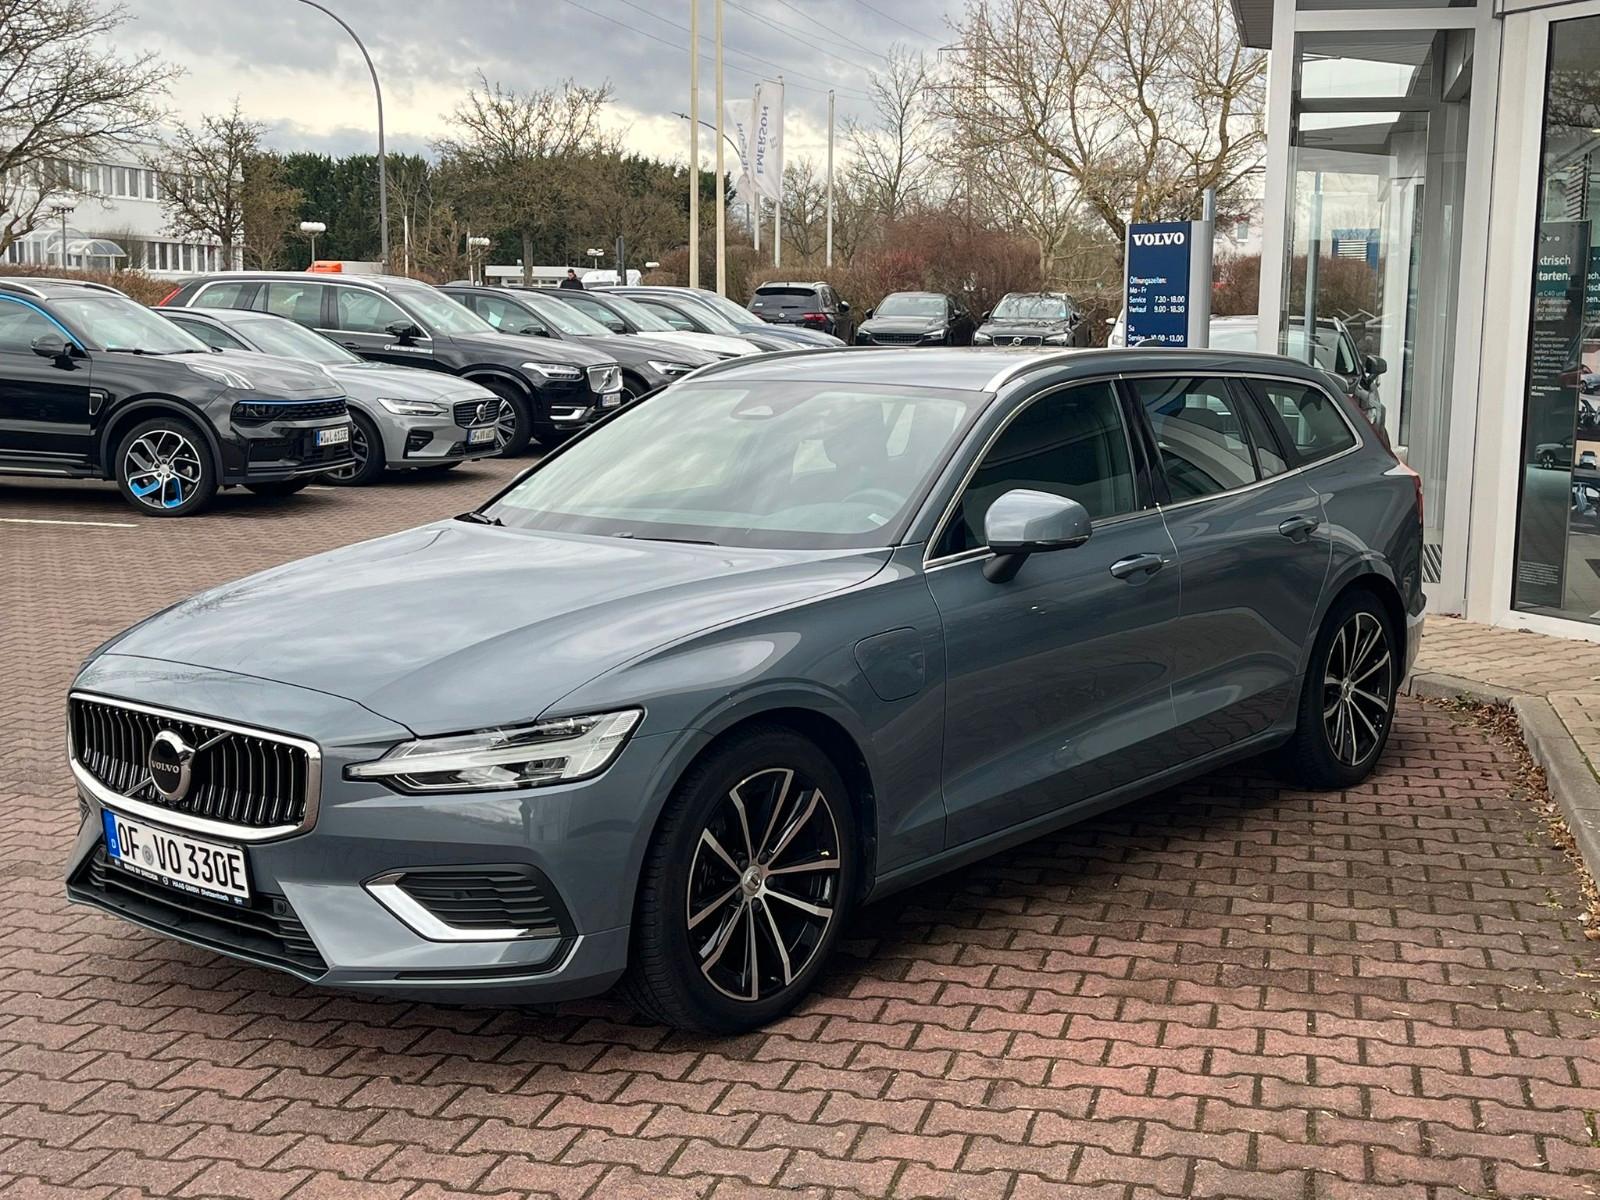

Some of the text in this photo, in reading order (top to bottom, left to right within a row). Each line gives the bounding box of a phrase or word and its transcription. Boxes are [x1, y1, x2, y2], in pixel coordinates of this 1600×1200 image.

[1132, 232, 1185, 246] VOLVO
[151, 760, 180, 774] VOLVO
[111, 838, 117, 849] D
[118, 822, 246, 891] OF VO 330E
